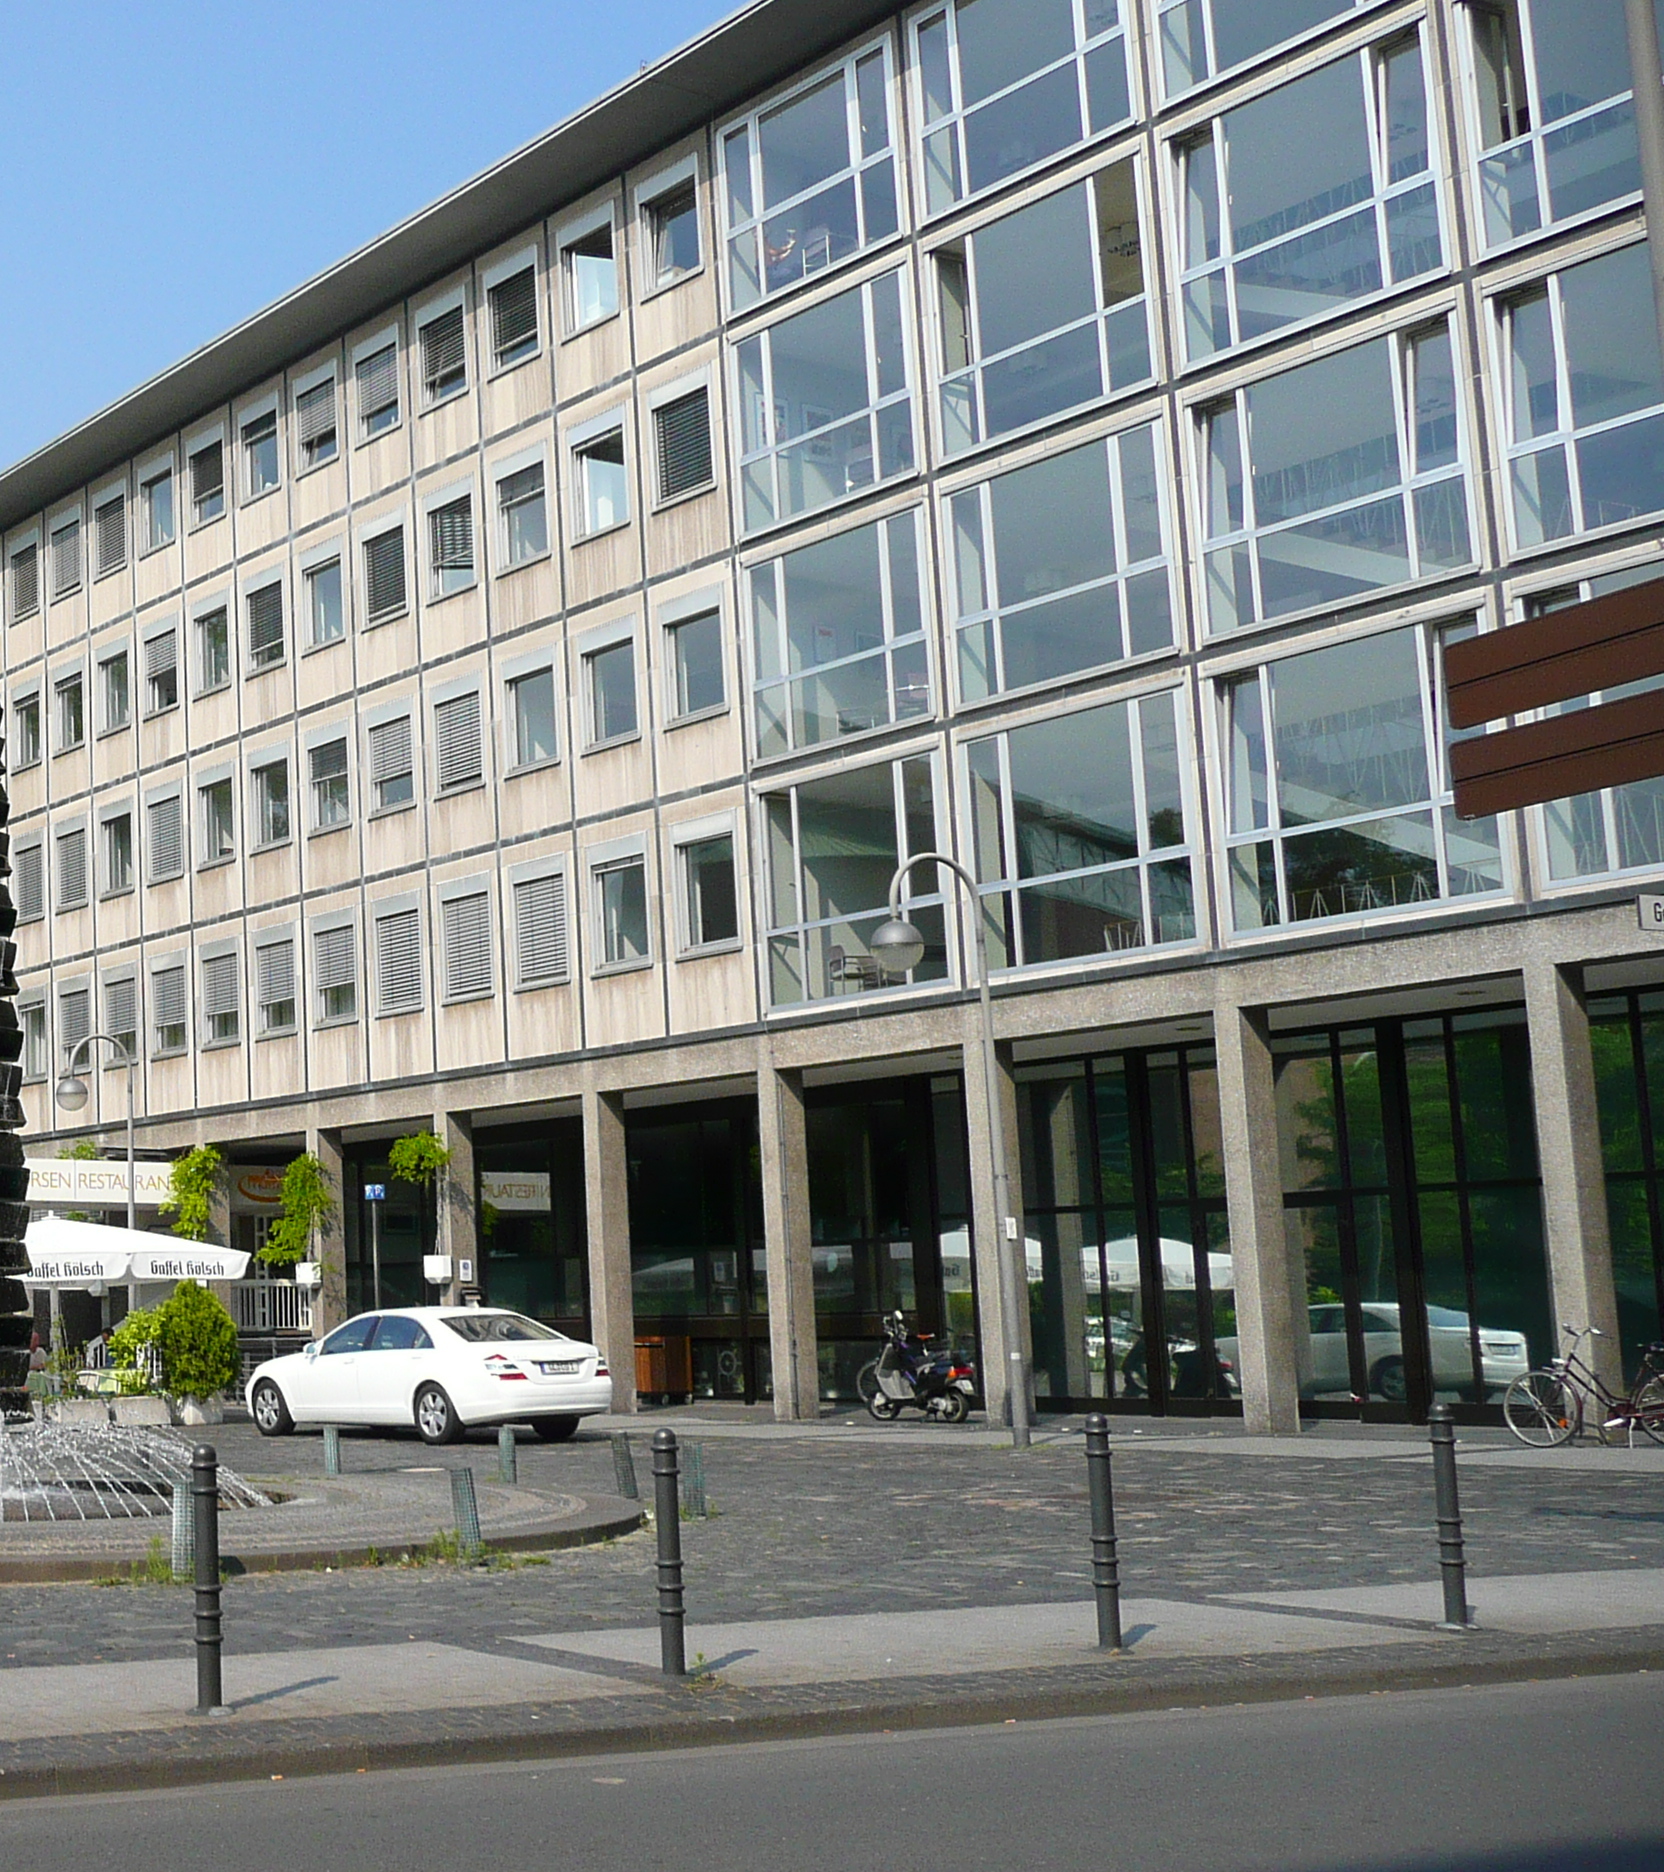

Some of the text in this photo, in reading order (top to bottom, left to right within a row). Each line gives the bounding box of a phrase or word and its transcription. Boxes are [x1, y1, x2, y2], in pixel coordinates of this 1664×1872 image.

[1654, 902, 1664, 922] G
[31, 1172, 170, 1190] RSEN RESTAURAN
[64, 1261, 103, 1277] Kölsch
[150, 1260, 224, 1276] Gaffel Kölsch
